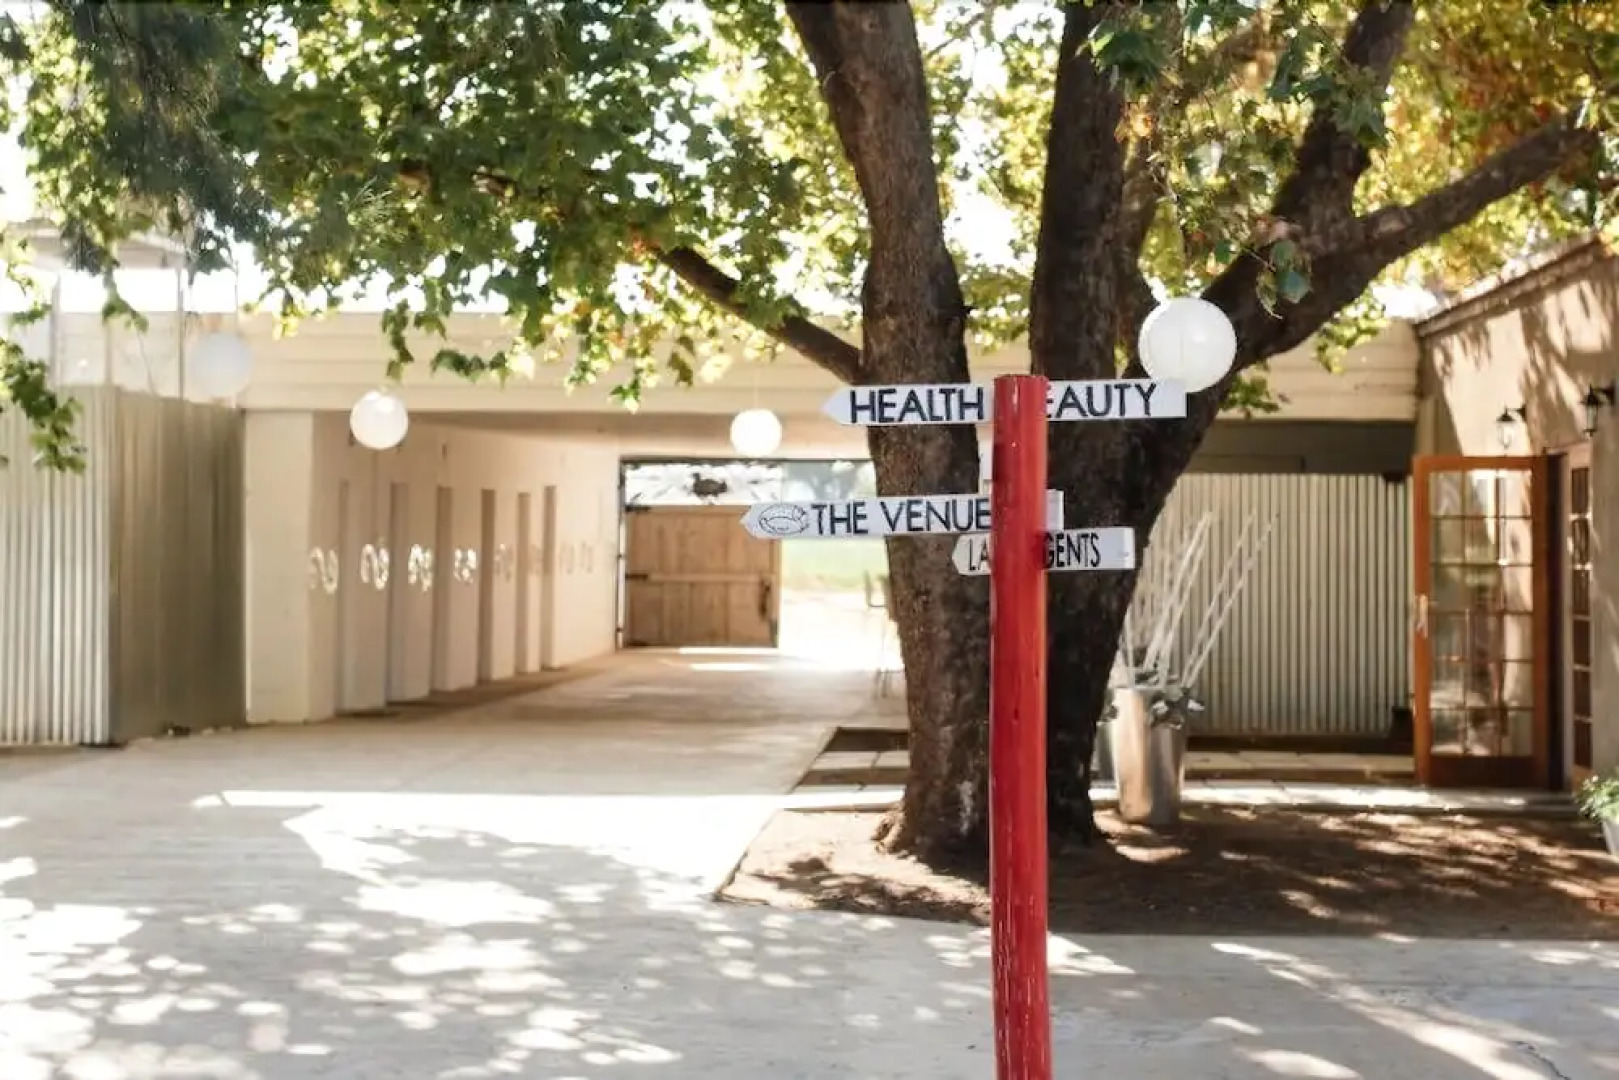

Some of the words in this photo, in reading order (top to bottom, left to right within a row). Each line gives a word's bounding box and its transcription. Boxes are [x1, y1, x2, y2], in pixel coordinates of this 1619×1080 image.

[850, 387, 984, 423] HEALTH
[810, 502, 869, 535] THE
[880, 498, 991, 532] VENUE
[1042, 532, 1101, 568] GENTS
